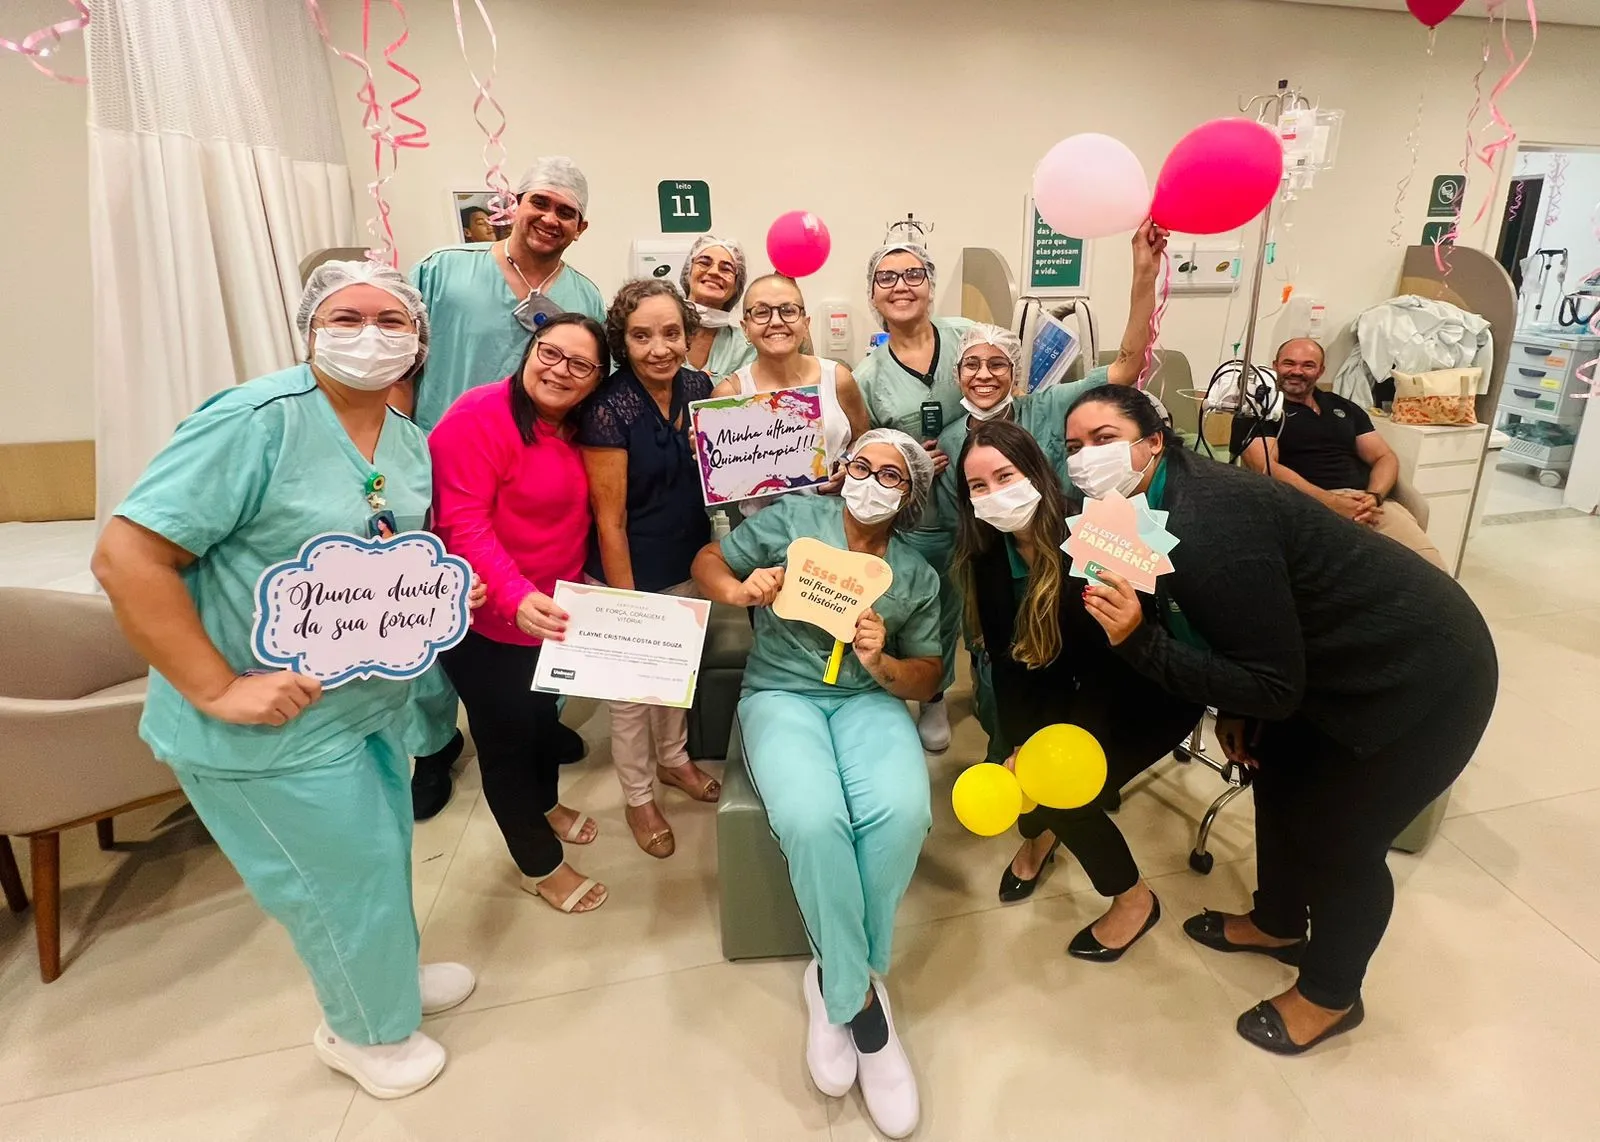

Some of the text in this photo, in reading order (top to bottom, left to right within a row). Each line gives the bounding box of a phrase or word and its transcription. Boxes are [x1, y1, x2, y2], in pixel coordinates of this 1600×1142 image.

[672, 195, 700, 216] 11
[1036, 258, 1072, 266] aproveitar
[716, 419, 806, 446] Minha última
[710, 434, 816, 468] Quimioterapia!!!
[1078, 530, 1156, 574] PARABÉNS!
[1120, 538, 1134, 549] DE
[286, 572, 450, 610] Nunca duvide
[799, 576, 858, 606] vai ficar para
[802, 559, 864, 595] Esse dia
[808, 592, 847, 614] história!
[294, 608, 436, 640] da sua força!
[579, 630, 602, 638] ELAYNE
[604, 633, 630, 642] CRISTINA
